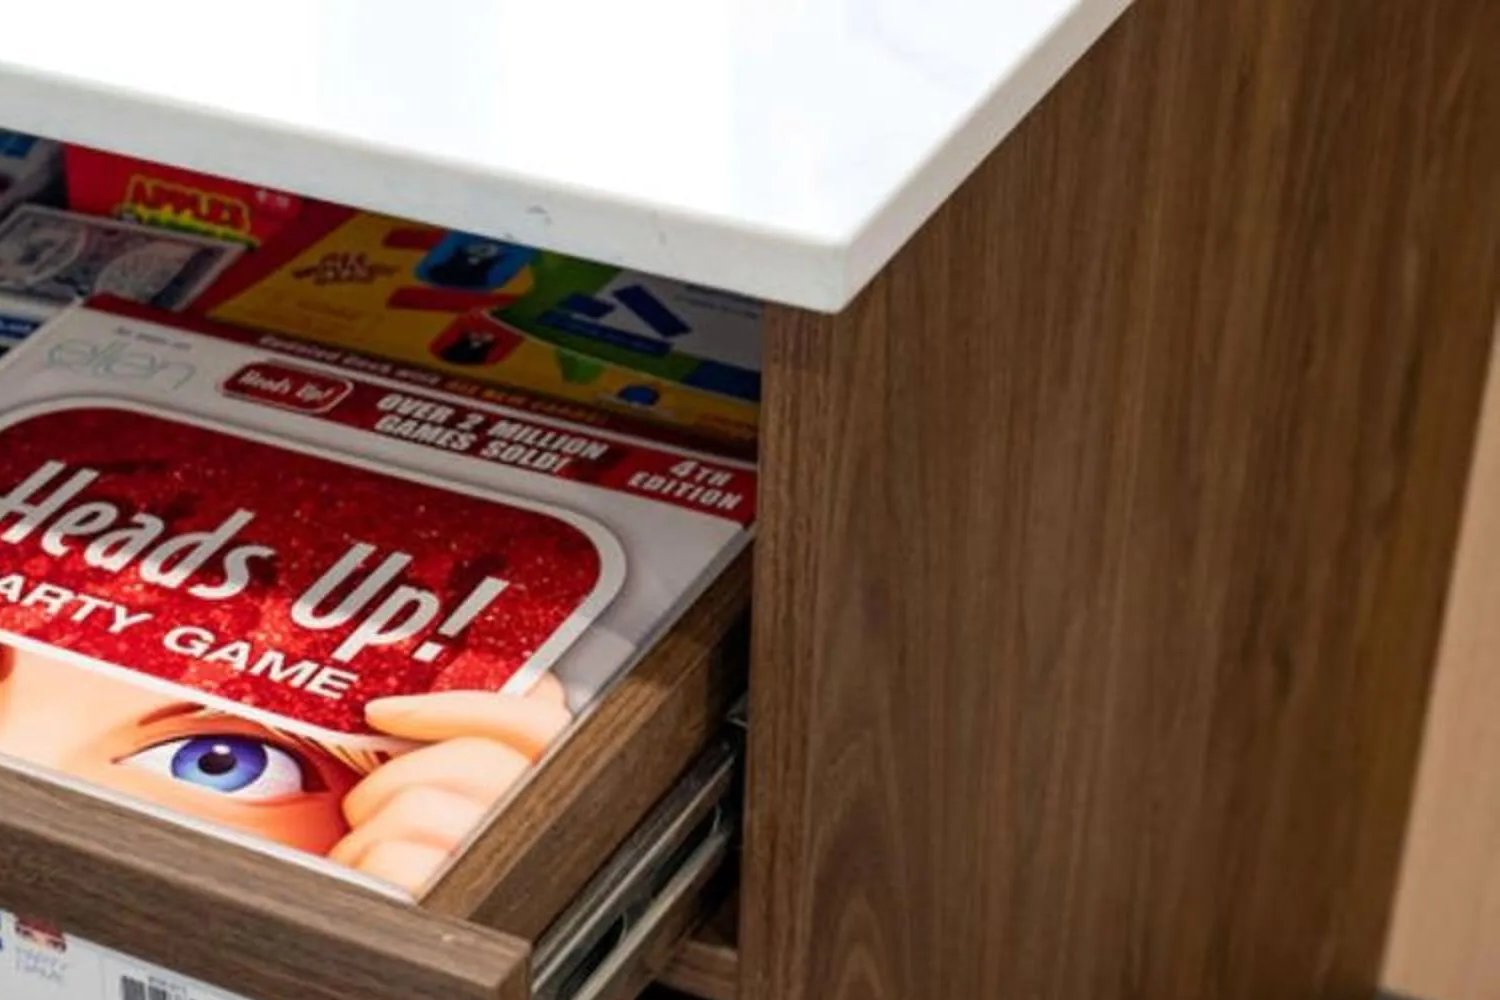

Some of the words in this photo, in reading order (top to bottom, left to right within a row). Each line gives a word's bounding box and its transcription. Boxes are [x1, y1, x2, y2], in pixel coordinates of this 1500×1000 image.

[374, 414, 479, 453] GAMES
[480, 440, 576, 476] SOLD!
[376, 392, 456, 425] OVER
[456, 410, 485, 433] 2
[487, 418, 609, 462] MILLION
[627, 471, 744, 512] EDITION
[668, 459, 735, 488] 4TH
[289, 541, 509, 662] Up!
[161, 624, 360, 702] GAME
